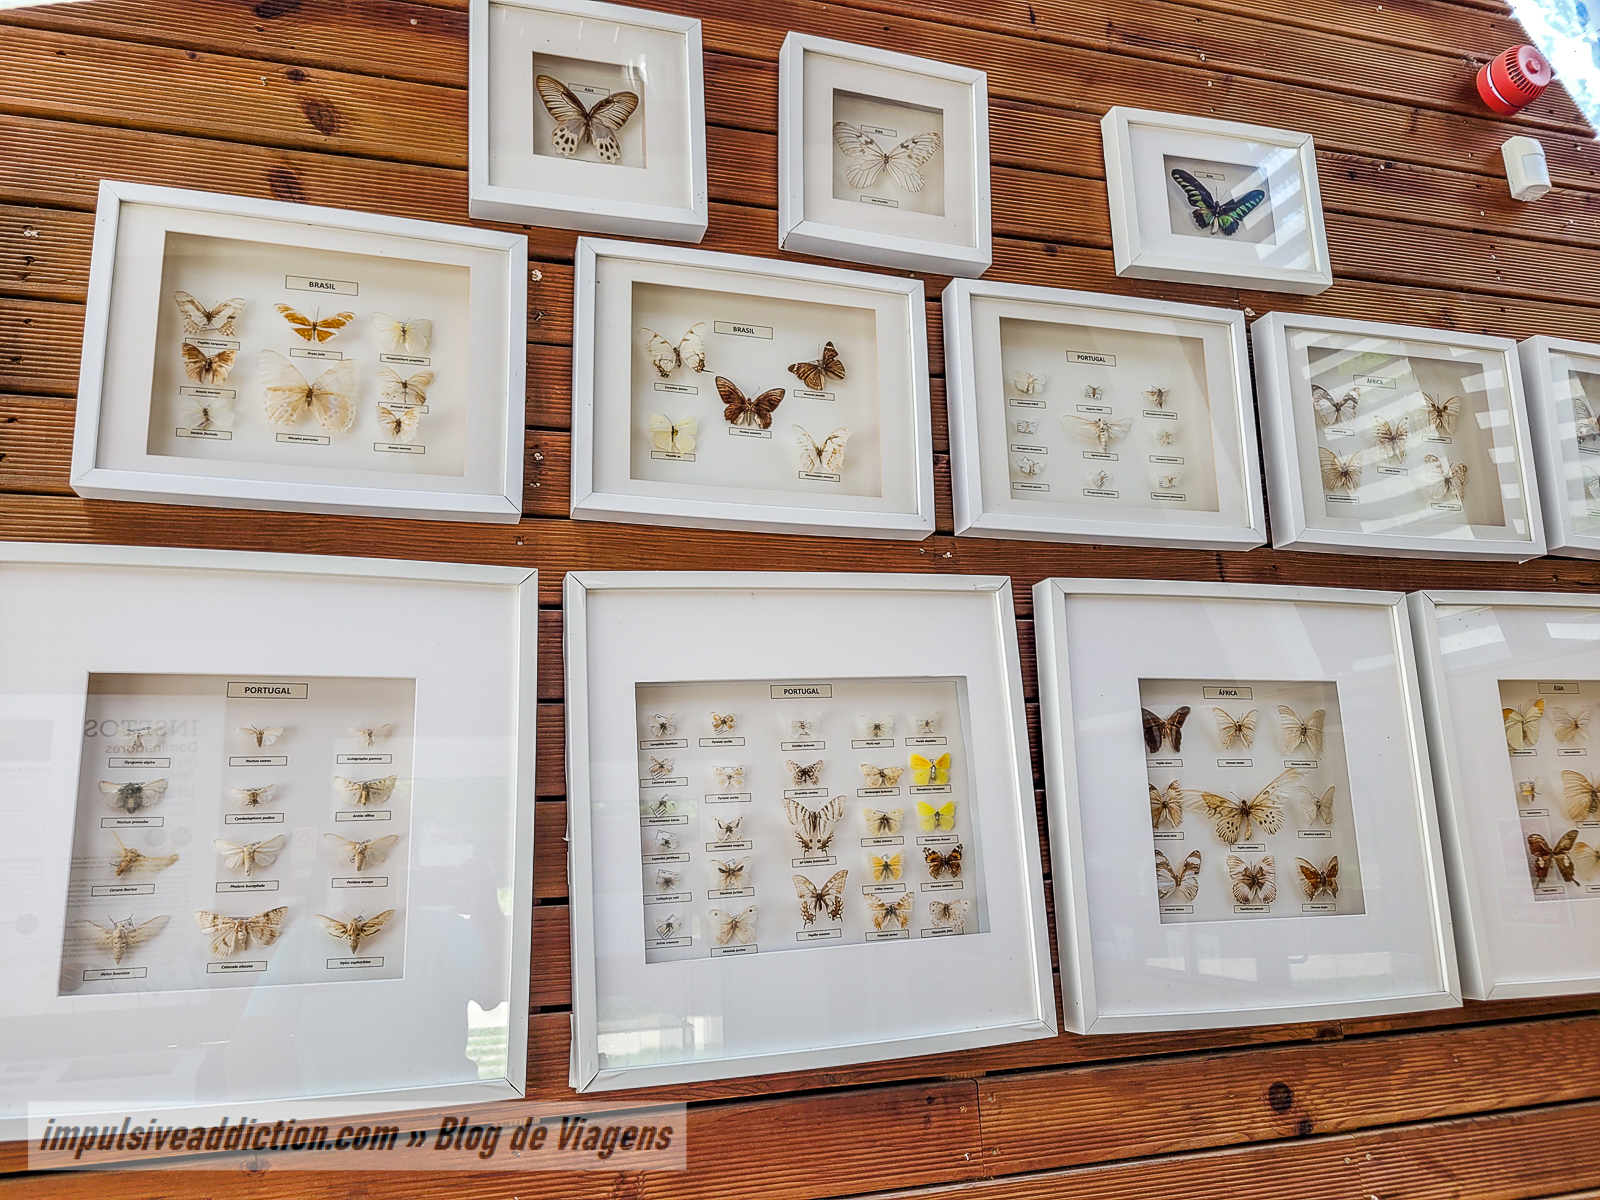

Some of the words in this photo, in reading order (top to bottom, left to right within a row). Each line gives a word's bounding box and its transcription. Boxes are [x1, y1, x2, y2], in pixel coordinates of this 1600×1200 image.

[309, 281, 336, 291] BRASIL
[733, 326, 755, 335] BRASIL
[1077, 354, 1107, 364] PORTUGAL
[244, 686, 292, 695] PORTUGAL
[1218, 687, 1239, 697] ÁFRICA
[1553, 684, 1565, 692] ÁSIA
